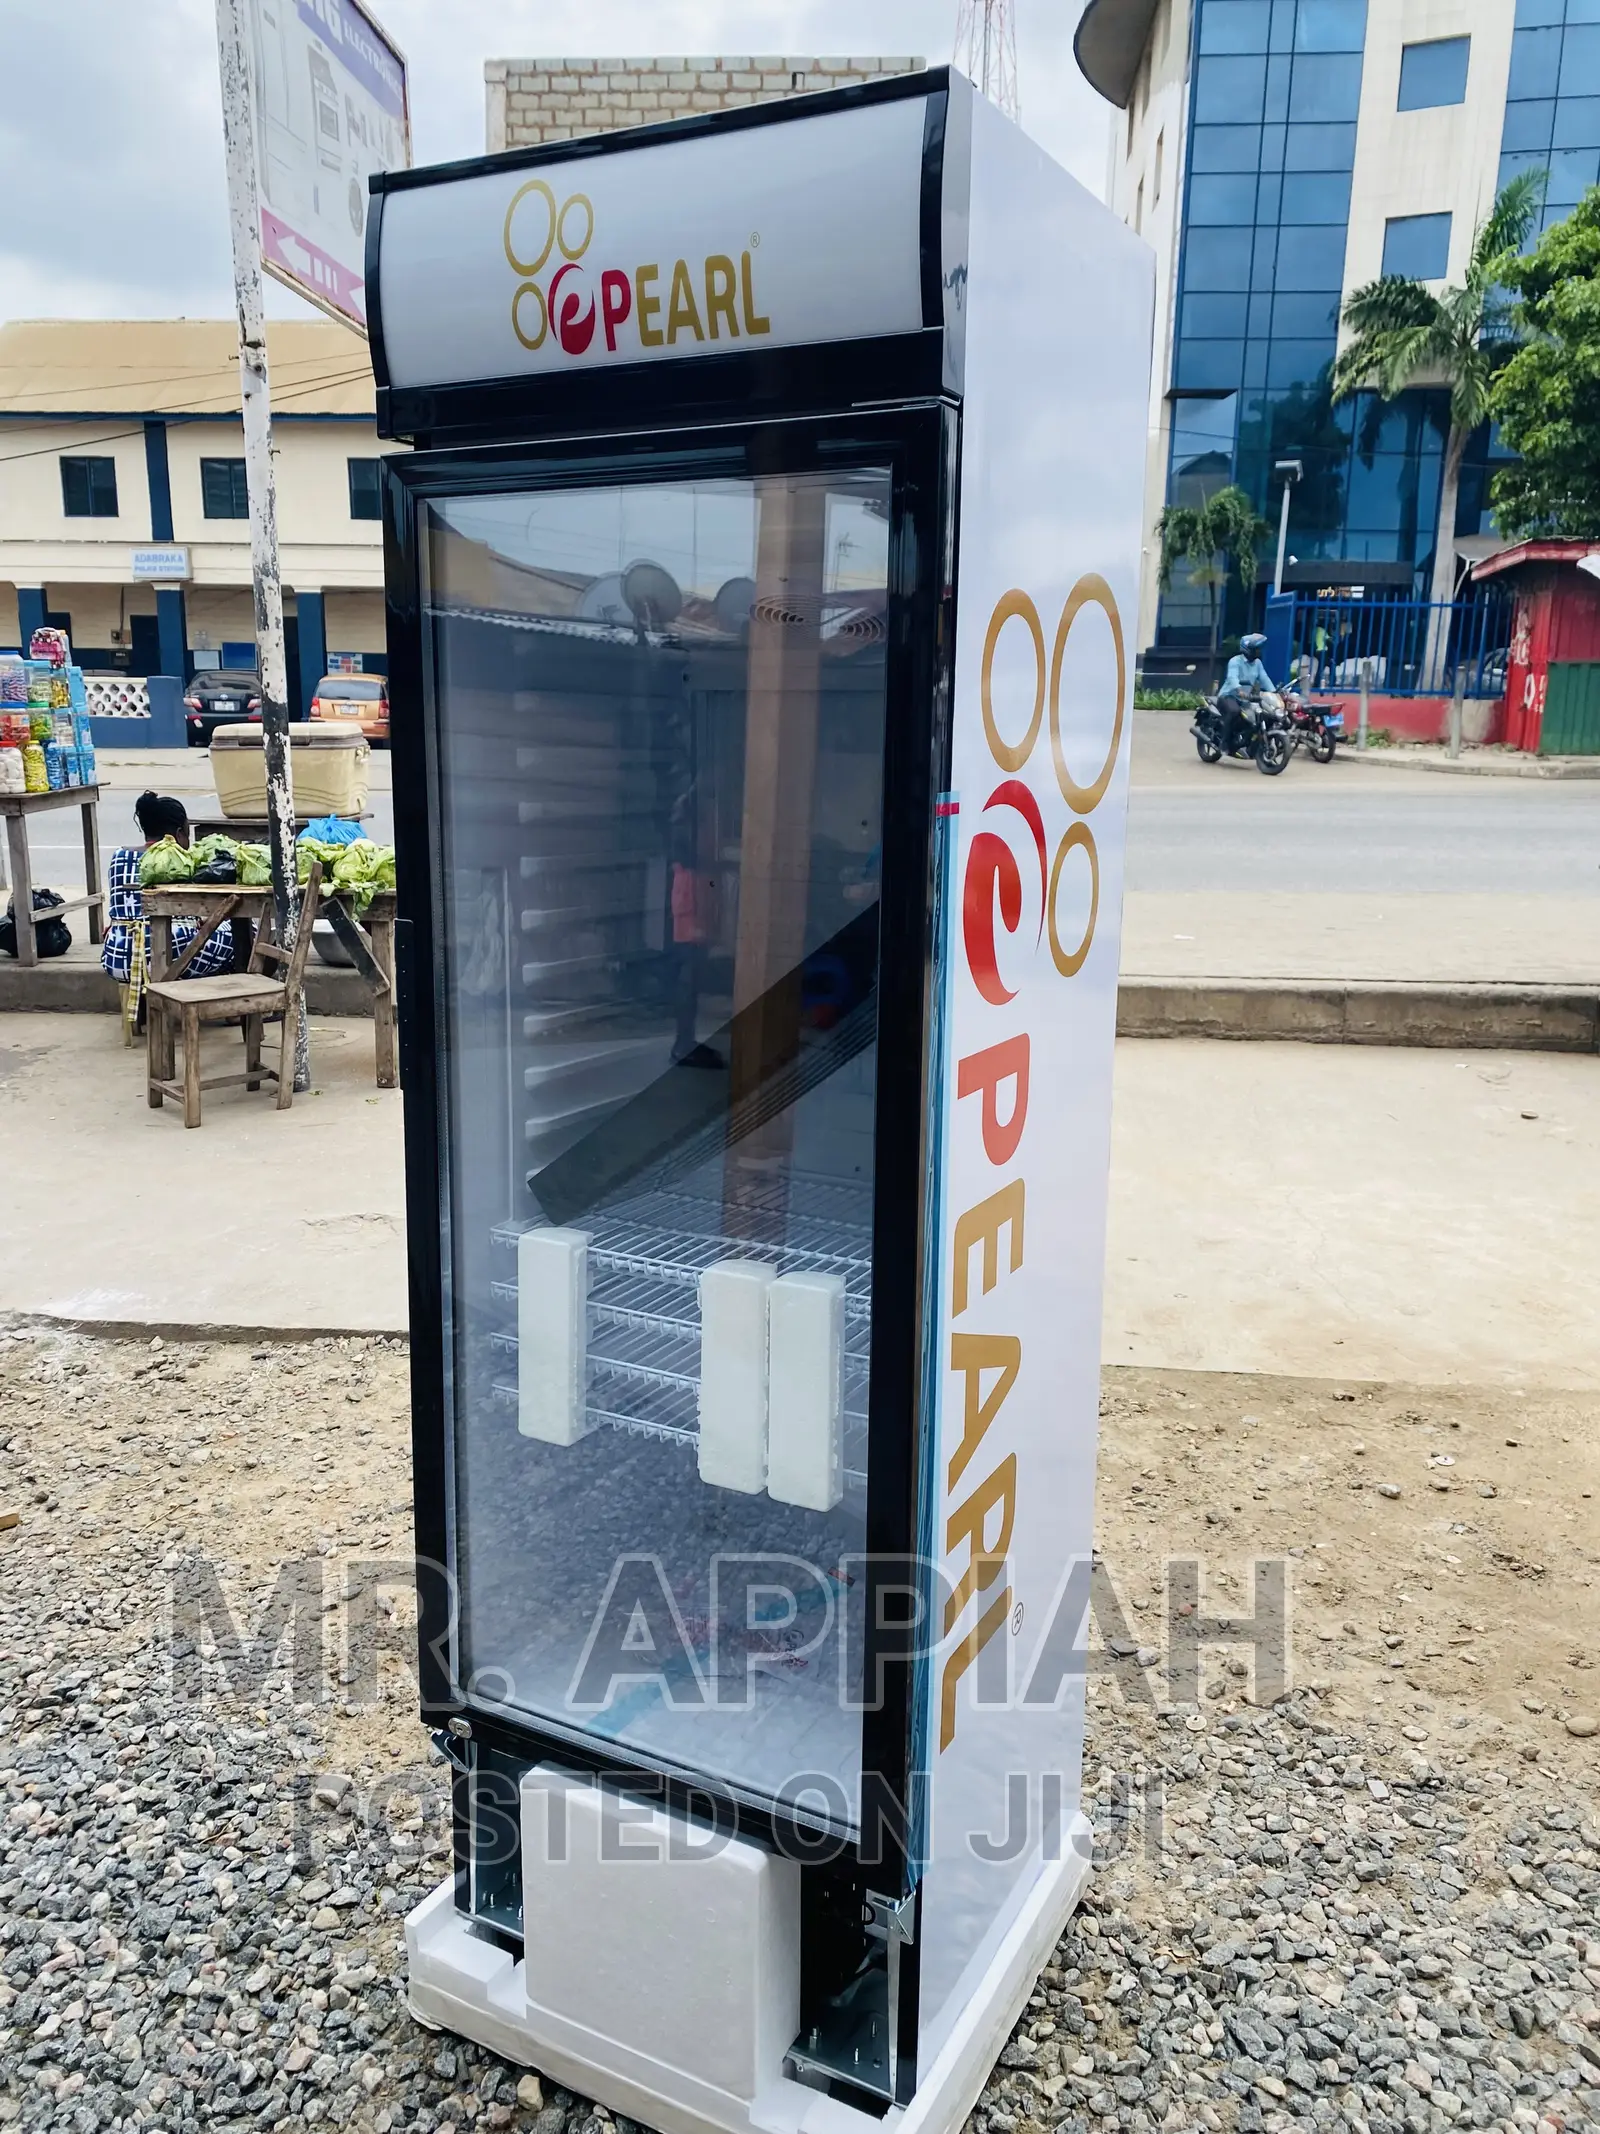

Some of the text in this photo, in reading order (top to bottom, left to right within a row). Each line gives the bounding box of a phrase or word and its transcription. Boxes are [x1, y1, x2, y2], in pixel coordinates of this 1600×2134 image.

[601, 250, 770, 351] PEARL
[134, 553, 184, 563] ADABRAKA
[940, 1032, 1030, 1756] PEARL
